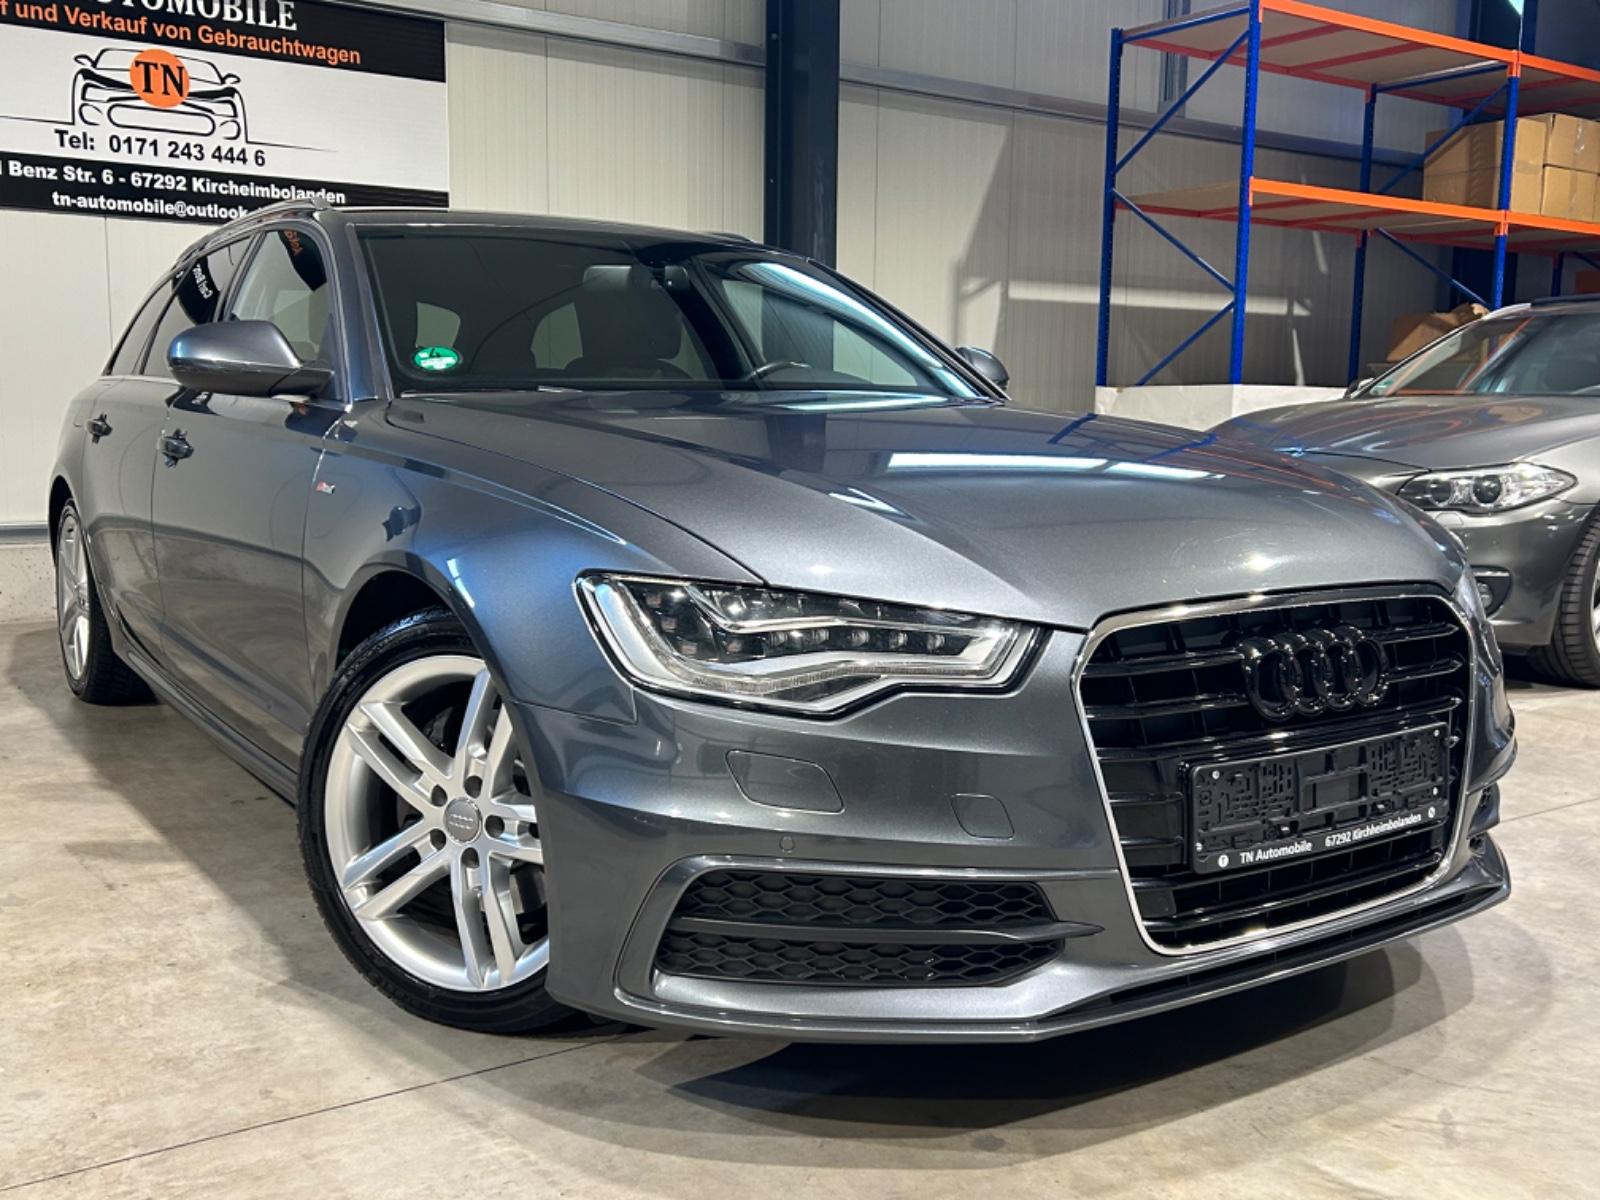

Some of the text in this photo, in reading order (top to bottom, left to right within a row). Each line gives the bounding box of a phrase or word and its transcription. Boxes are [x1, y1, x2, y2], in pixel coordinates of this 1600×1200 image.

[15, 3, 58, 23] und
[64, 5, 148, 35] Verkauf
[153, 21, 192, 41] von
[198, 26, 361, 65] Gebrauchtwagen
[135, 60, 186, 98] TN
[55, 129, 265, 167] Tel: 0171 243 444 6
[9, 160, 58, 180] Benz
[63, 165, 96, 184] Str.
[102, 170, 113, 185] 6
[131, 172, 187, 192] 67292
[1240, 850, 1254, 865] TN
[1255, 839, 1313, 861] Automobile
[1325, 831, 1351, 847] 67292
